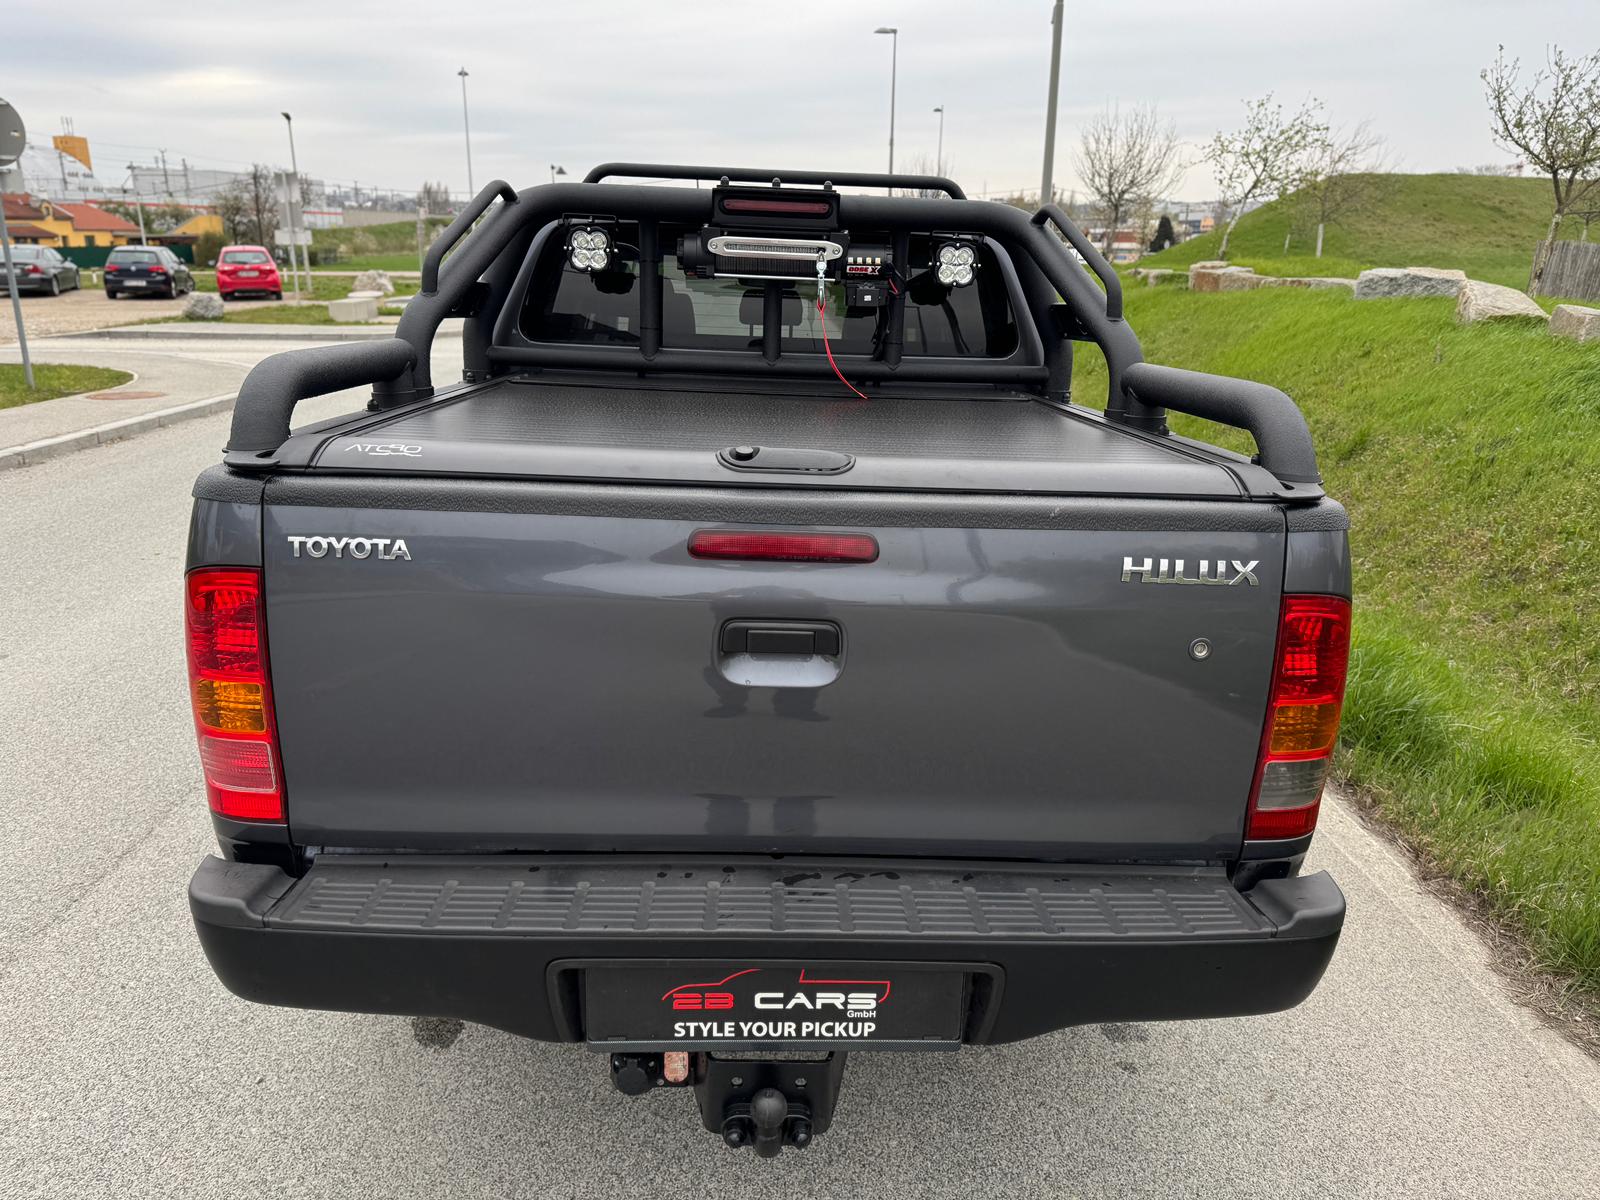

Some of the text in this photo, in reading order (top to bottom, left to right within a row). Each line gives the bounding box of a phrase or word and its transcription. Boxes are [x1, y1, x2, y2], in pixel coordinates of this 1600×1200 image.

[287, 536, 412, 561] TOYOTA
[1121, 556, 1260, 586] HILUX
[672, 992, 877, 1010] 2B CARS
[846, 1010, 877, 1018] GmbH
[673, 1021, 877, 1038] STYLE YOUR PICKUP
